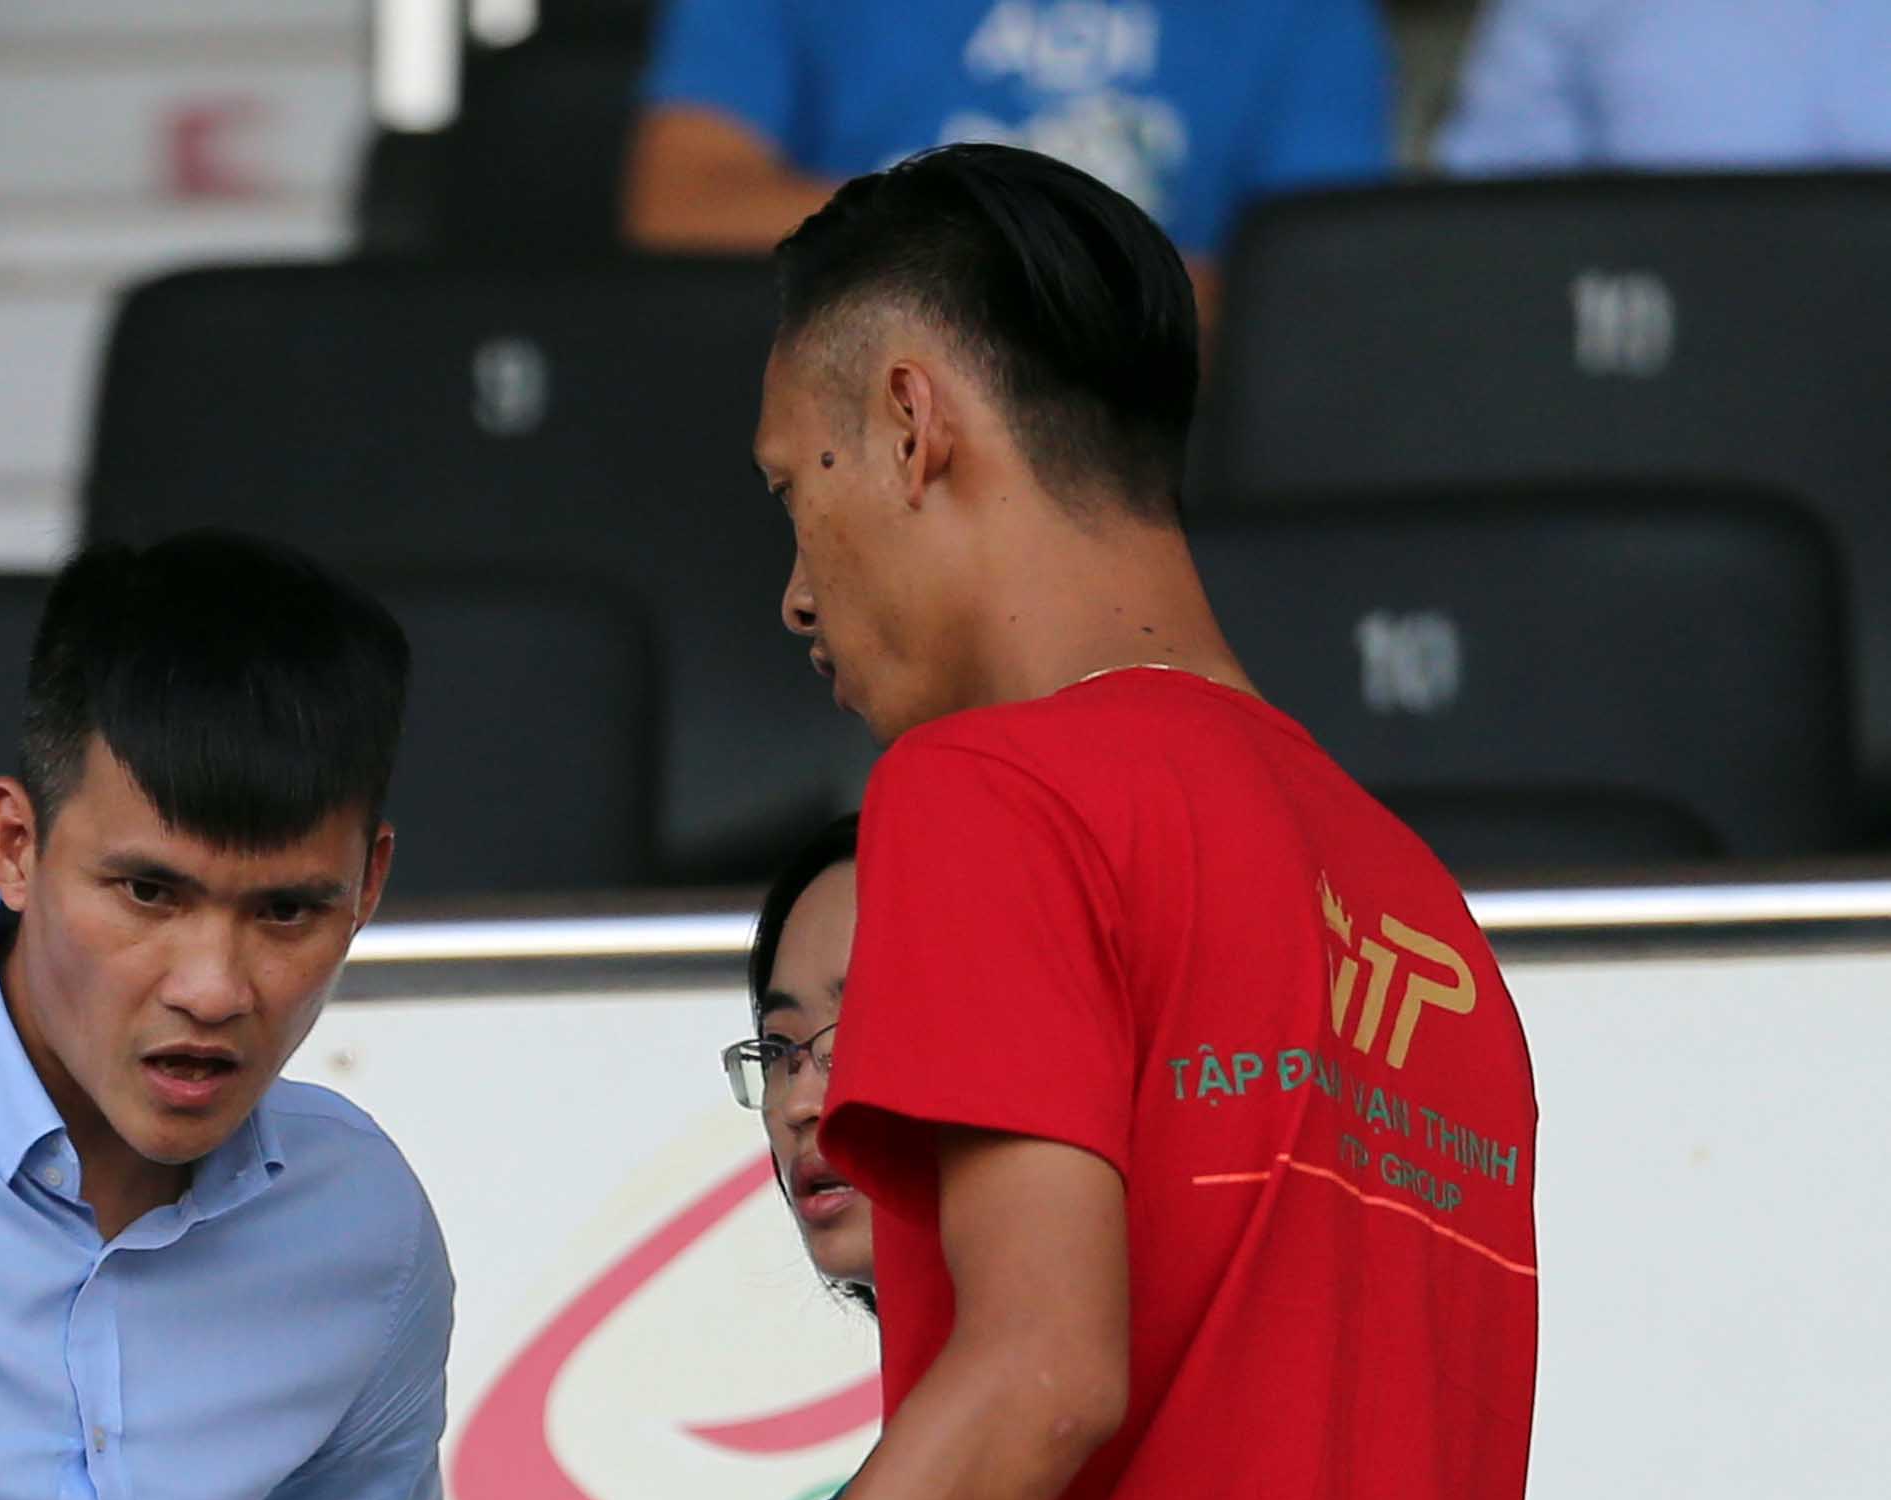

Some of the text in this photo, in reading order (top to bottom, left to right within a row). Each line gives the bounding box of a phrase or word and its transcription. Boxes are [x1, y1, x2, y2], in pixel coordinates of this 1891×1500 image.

[1166, 1043, 1264, 1109] TẬP
[1420, 1106, 1519, 1186] THỊNH
[1380, 1152, 1463, 1213] GROUP
